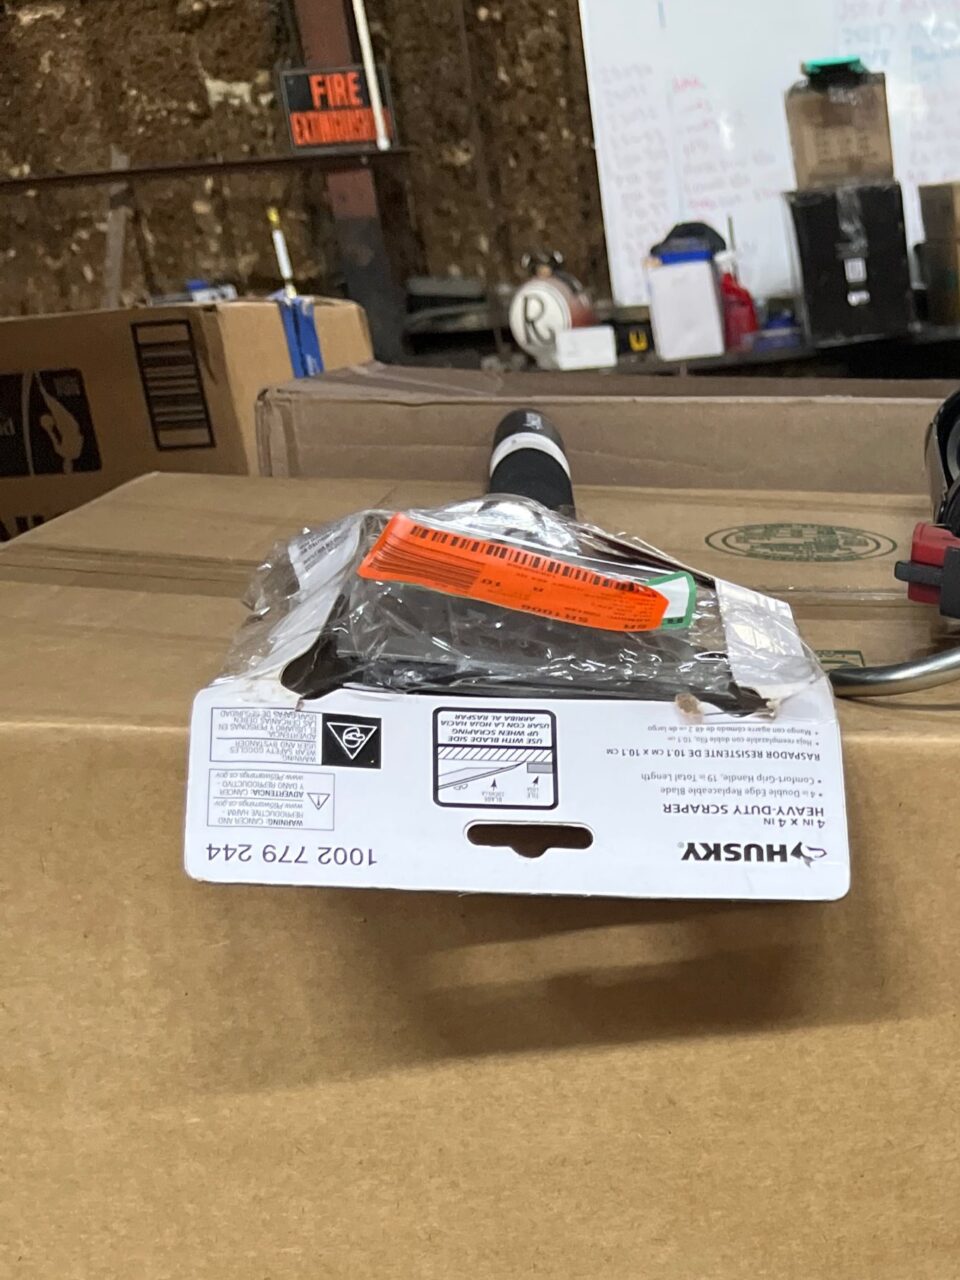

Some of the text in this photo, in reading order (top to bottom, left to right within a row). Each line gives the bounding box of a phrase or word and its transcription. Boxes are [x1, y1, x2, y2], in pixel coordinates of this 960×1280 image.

[309, 71, 363, 110] FIRE
[666, 749, 684, 757] 10.1
[688, 749, 701, 758] DE
[704, 750, 762, 759] RESISTENTE
[766, 751, 820, 760] RASPADOR
[641, 772, 672, 781] Length
[757, 774, 815, 785] Comfort-Grip
[661, 787, 685, 795] Blade
[688, 786, 742, 796] Replaceable
[745, 787, 766, 796] Edge
[769, 789, 800, 797] Double
[662, 804, 824, 816] HEAVY-DUTY SCRAPER
[778, 818, 786, 827] 4
[817, 820, 825, 828] 4
[206, 844, 377, 866] 1002 779 244
